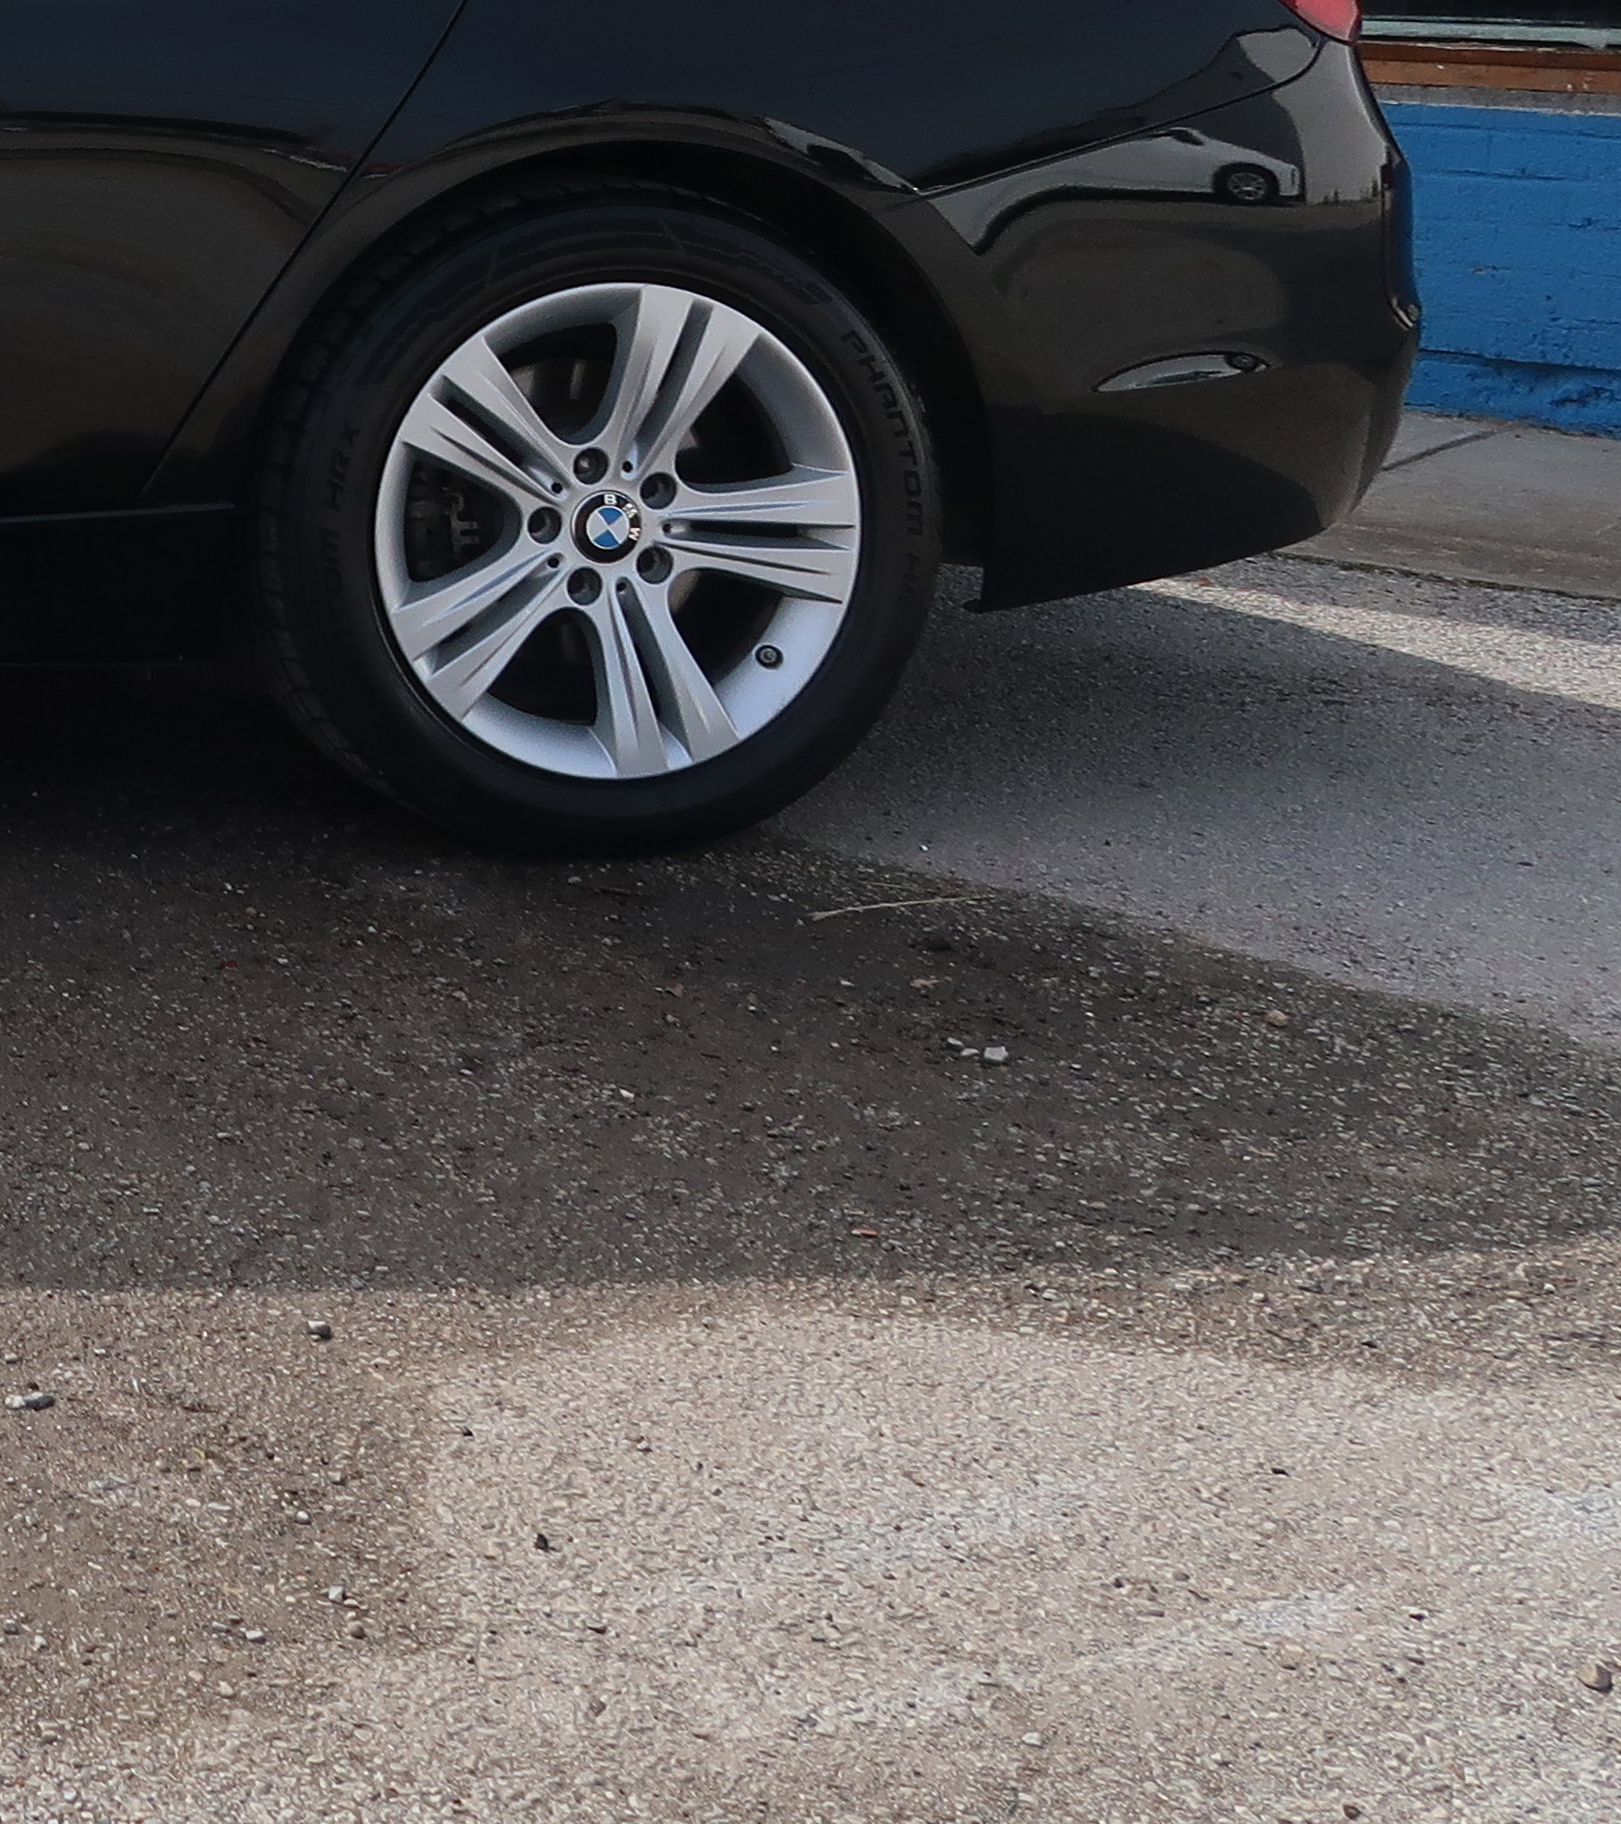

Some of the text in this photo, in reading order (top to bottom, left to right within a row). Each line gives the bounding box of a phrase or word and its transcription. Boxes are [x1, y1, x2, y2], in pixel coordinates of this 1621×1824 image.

[321, 418, 361, 514] HRX
[839, 328, 925, 537] PHANTOM
[603, 493, 641, 541] BMW
